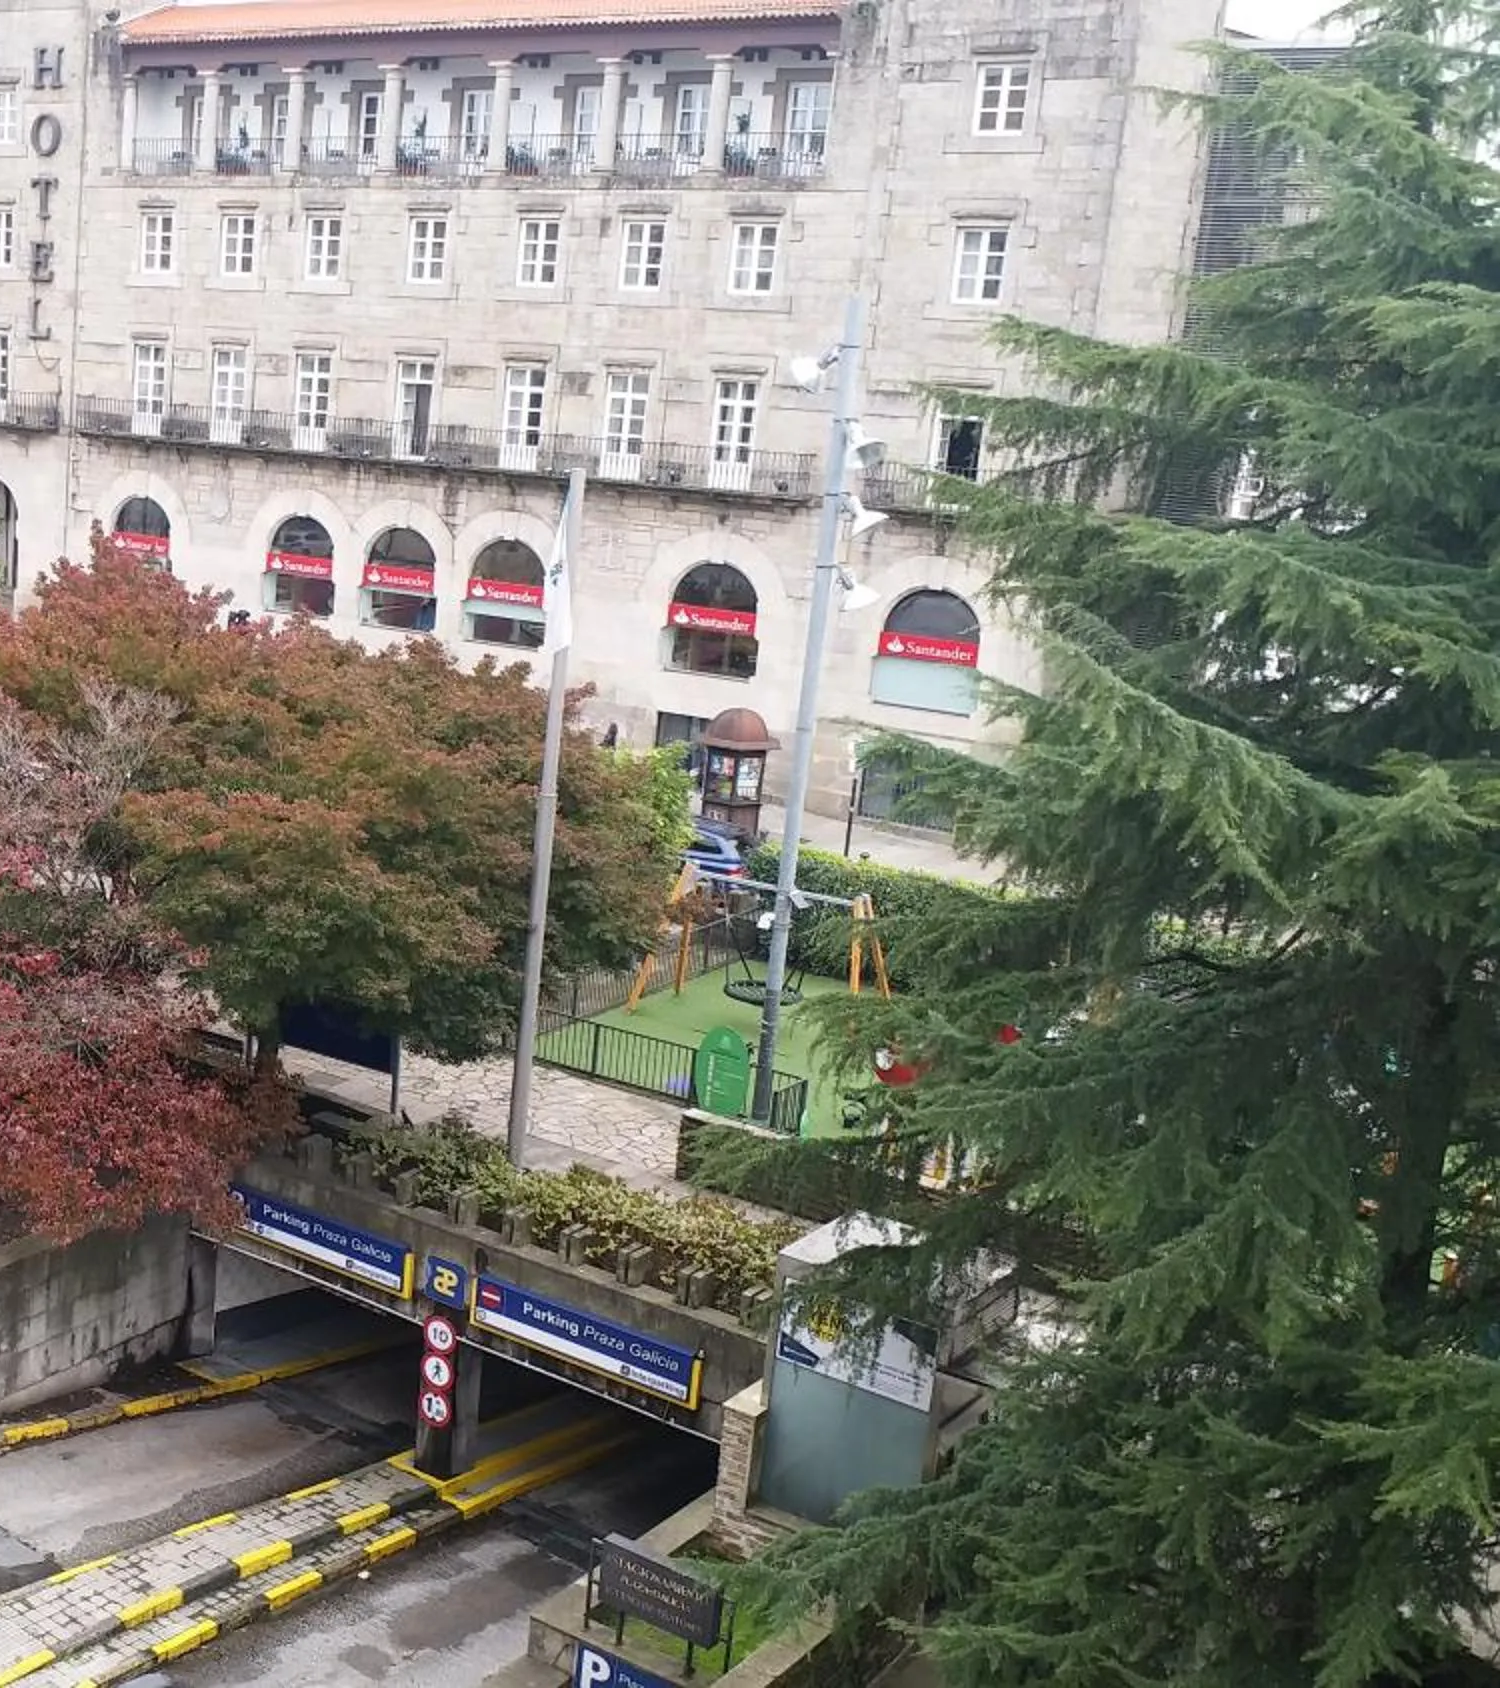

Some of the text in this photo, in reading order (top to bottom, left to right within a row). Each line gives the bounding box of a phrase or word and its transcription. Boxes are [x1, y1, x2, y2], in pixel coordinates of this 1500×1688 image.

[29, 46, 64, 341] HOTEL
[282, 560, 329, 576] Santander
[380, 571, 431, 588] Santander
[486, 586, 539, 604] Santander
[690, 612, 751, 632] Santander
[905, 641, 974, 661] Santander
[263, 1203, 393, 1263] Parking Praza Galicia
[432, 1326, 449, 1343] 10
[523, 1301, 680, 1372] Parking Praza Galicia
[580, 1648, 611, 1688] P
